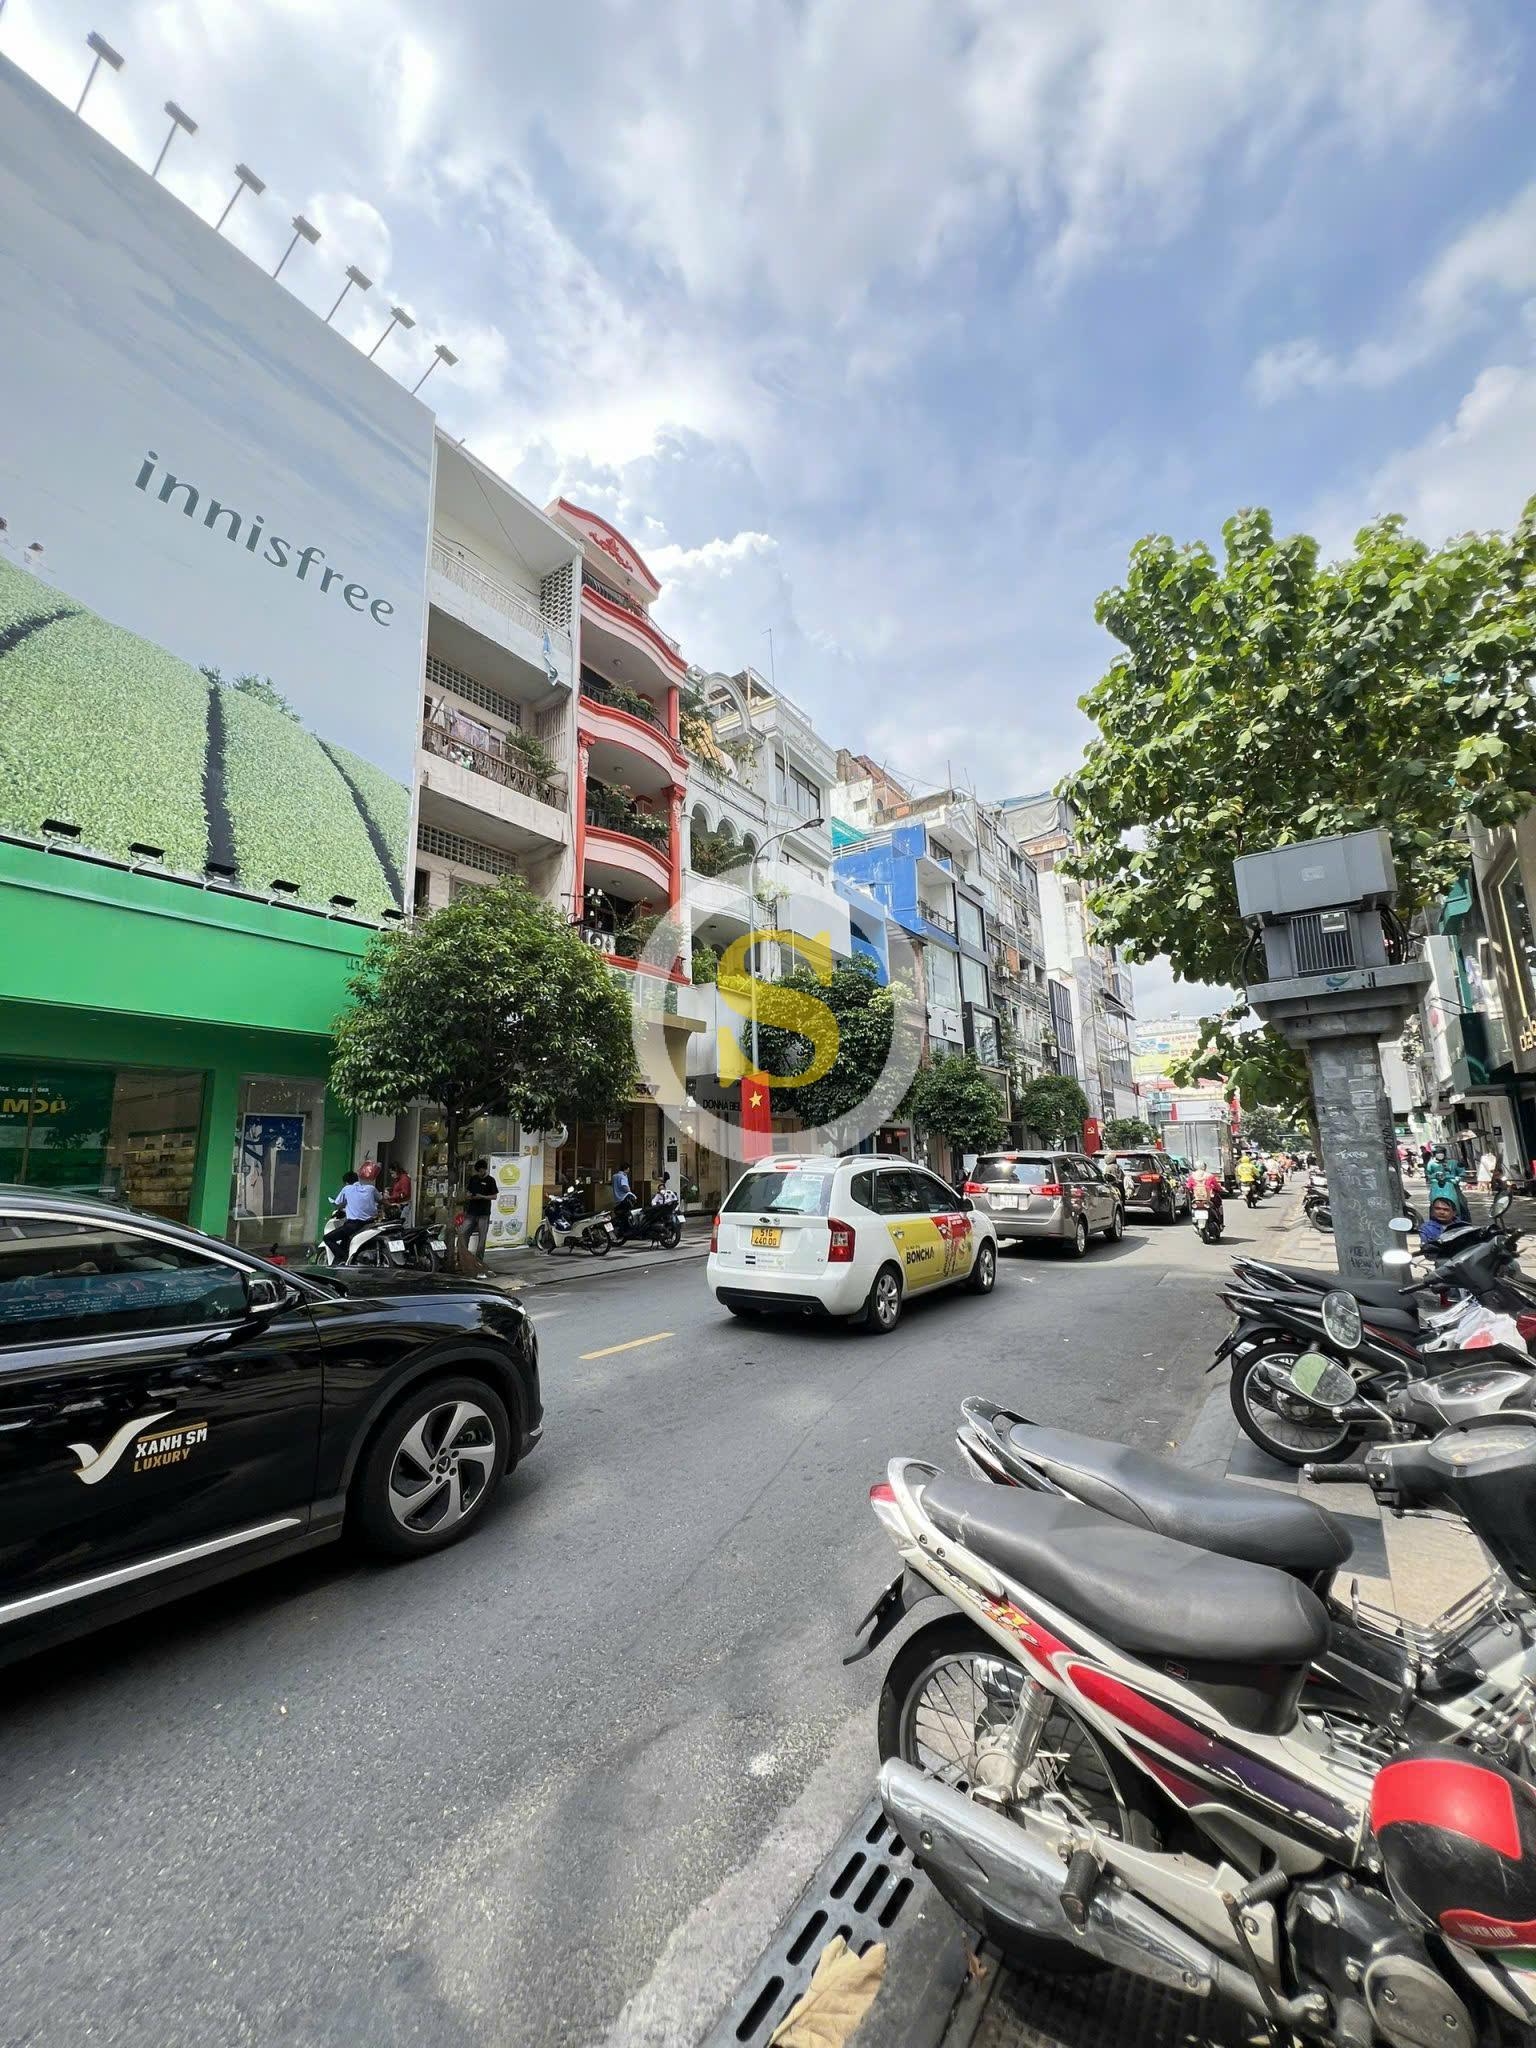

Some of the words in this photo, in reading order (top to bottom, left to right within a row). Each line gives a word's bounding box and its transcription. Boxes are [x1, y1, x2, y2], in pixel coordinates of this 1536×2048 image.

[135, 450, 394, 627] innisfree
[703, 1099, 729, 1110] DONNA
[760, 1228, 773, 1237] 51G
[906, 1246, 935, 1265] BONCHA
[135, 1433, 182, 1459] XANH
[185, 1428, 207, 1446] SM
[133, 1447, 190, 1473] LUXURY
